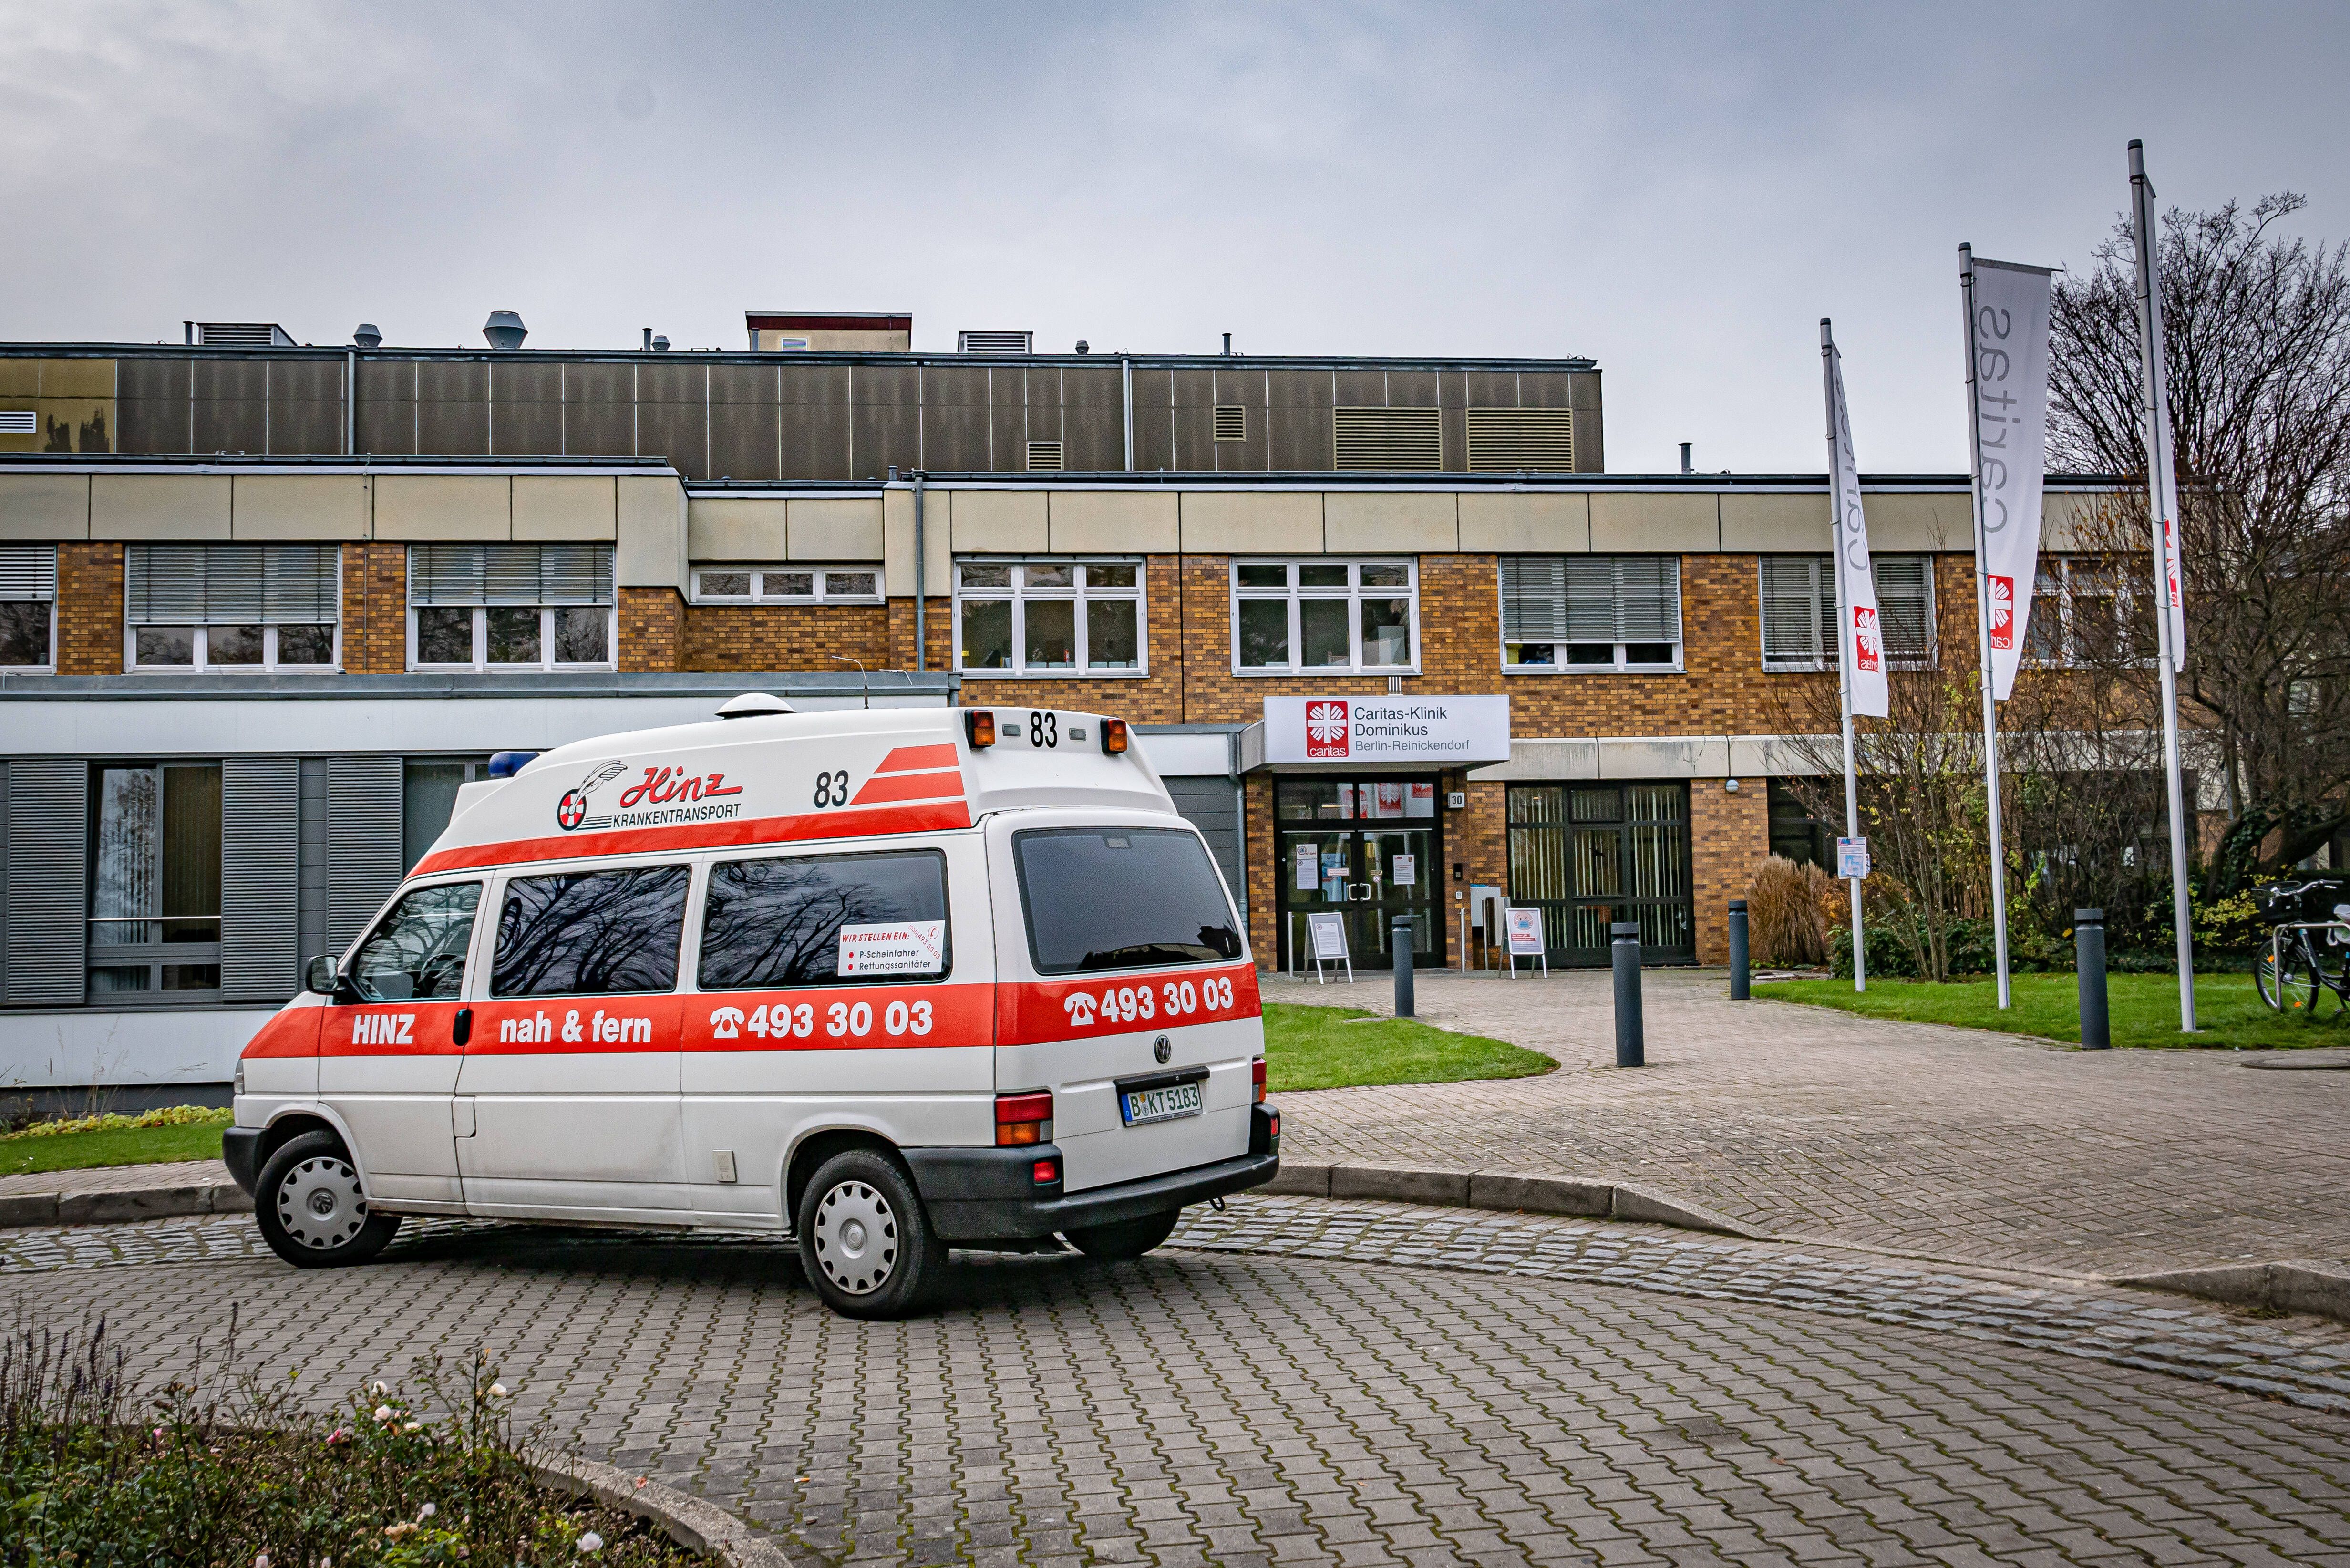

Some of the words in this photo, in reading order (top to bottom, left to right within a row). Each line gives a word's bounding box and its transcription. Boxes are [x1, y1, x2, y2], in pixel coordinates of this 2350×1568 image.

[1354, 706, 1448, 721] Caritas-Klinik
[1030, 711, 1058, 748] 83
[1354, 723, 1428, 737] Dominikus
[1309, 745, 1347, 757] caritas
[1355, 739, 1470, 752] Berlin-Reinickendorf
[619, 766, 743, 808] Hinz
[814, 769, 849, 808] 83
[1452, 795, 1463, 805] 30
[613, 803, 742, 828] KRANKENTRANSPORT
[842, 933, 857, 943] WIR
[858, 932, 892, 942] STELLEN
[893, 931, 910, 940] EIN:
[859, 949, 919, 959] P-Scheinfahrer
[927, 943, 934, 952] 30
[933, 950, 940, 959] 03
[859, 960, 931, 971] Rettungssanitäter
[1101, 985, 1155, 1023] 493
[1163, 980, 1196, 1016] 30
[1202, 976, 1234, 1011] 03
[352, 1014, 415, 1044] HINZ
[500, 1010, 552, 1042] nah
[561, 1009, 584, 1042] &
[592, 1009, 652, 1042] fern
[747, 1003, 814, 1039] 493
[826, 1001, 873, 1037] 30
[885, 1000, 933, 1036] 03
[1155, 1034, 1172, 1063] VW
[1130, 1096, 1141, 1117] B
[1147, 1091, 1165, 1114] KT
[1166, 1086, 1199, 1111] 5183
